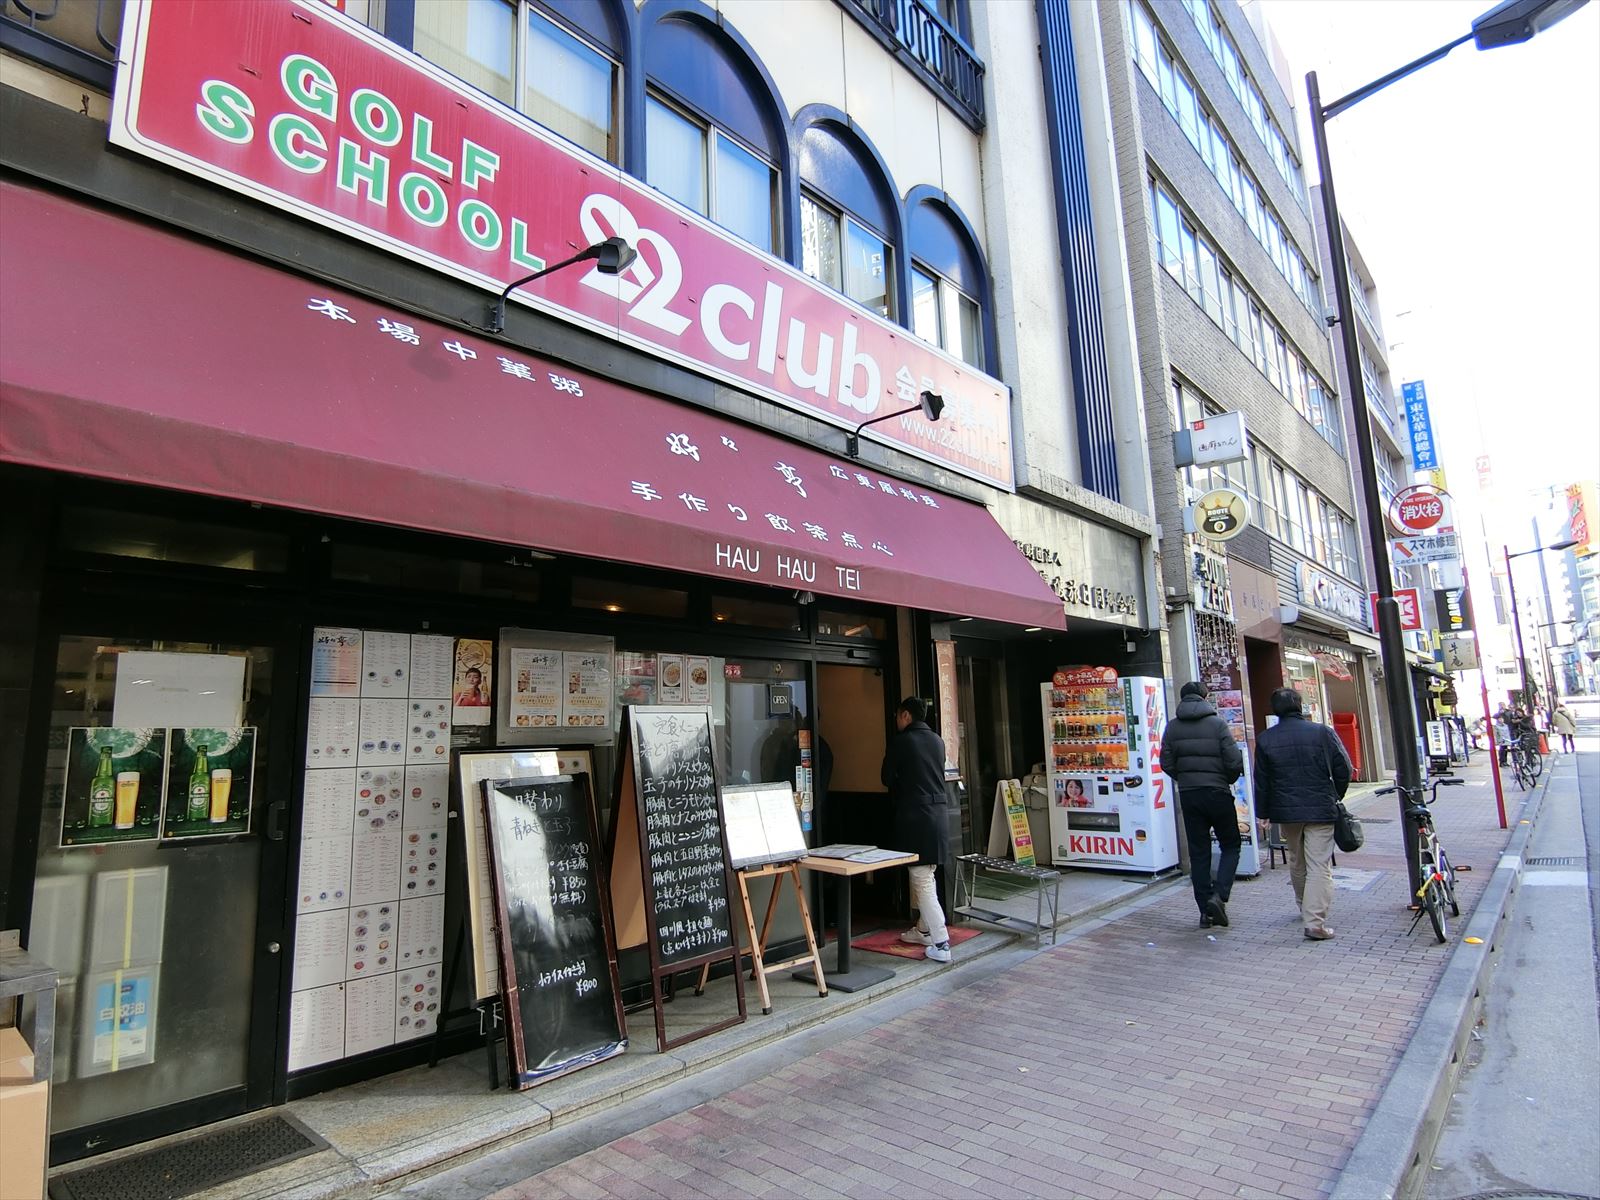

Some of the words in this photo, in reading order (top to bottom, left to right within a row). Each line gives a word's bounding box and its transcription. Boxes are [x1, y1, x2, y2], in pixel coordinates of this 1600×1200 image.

[280, 53, 501, 189] GOLF
[196, 79, 547, 273] SCHOOL
[579, 193, 693, 337] 22
[700, 280, 882, 415] club
[307, 297, 584, 398] 本場中華粥
[829, 464, 940, 509] 広東風料理
[631, 480, 894, 557] 手作り飲茶点心
[1401, 502, 1441, 521] 消火栓
[1410, 535, 1456, 551] スマホ修理
[715, 542, 760, 573] HAU
[777, 554, 816, 583] HAU
[835, 565, 861, 591] TEI
[772, 695, 788, 705] OPEN
[514, 789, 563, 812] 日替わり
[1069, 834, 1135, 857] KIRIN
[562, 876, 587, 892] ¥850
[708, 896, 727, 914] ¥950
[575, 978, 598, 998] ¥800
